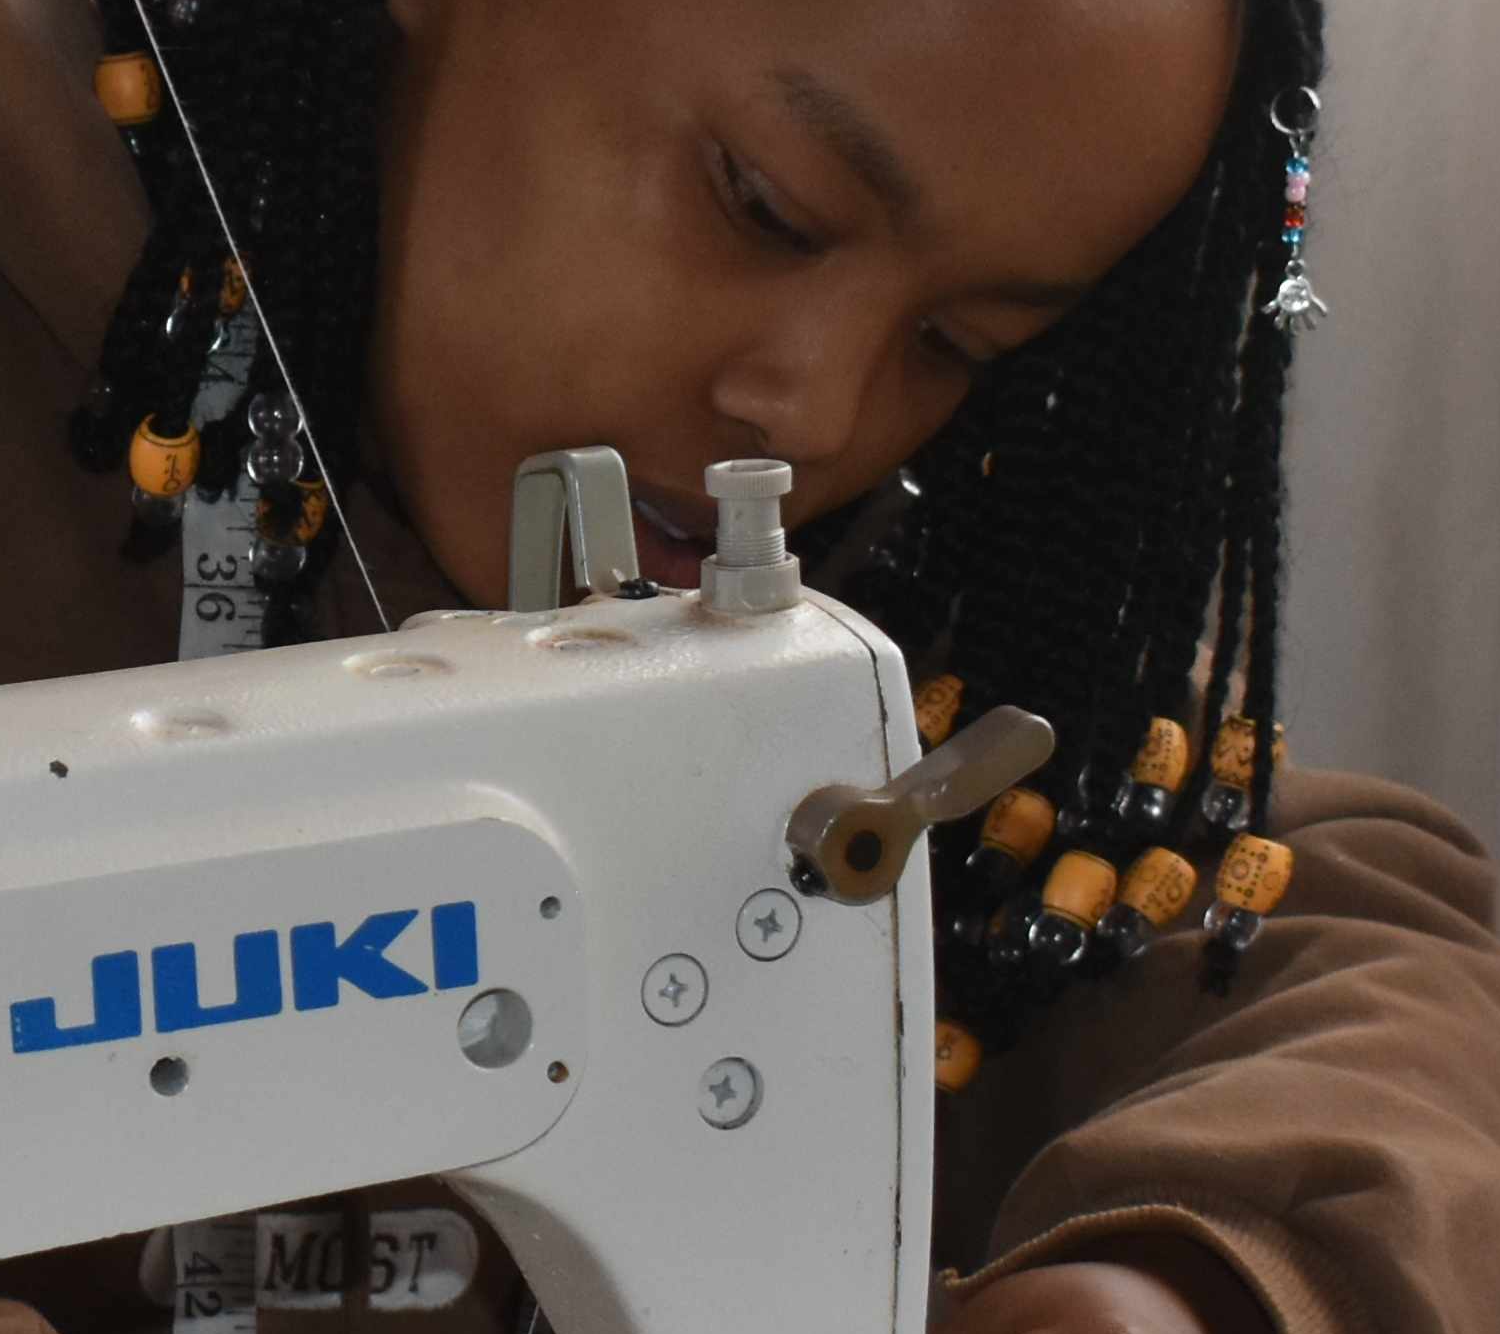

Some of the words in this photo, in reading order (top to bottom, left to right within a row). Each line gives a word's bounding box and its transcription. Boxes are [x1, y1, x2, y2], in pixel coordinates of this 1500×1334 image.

[196, 552, 238, 622] 36
[10, 900, 479, 1054] JUKI
[185, 1252, 222, 1318] 42
